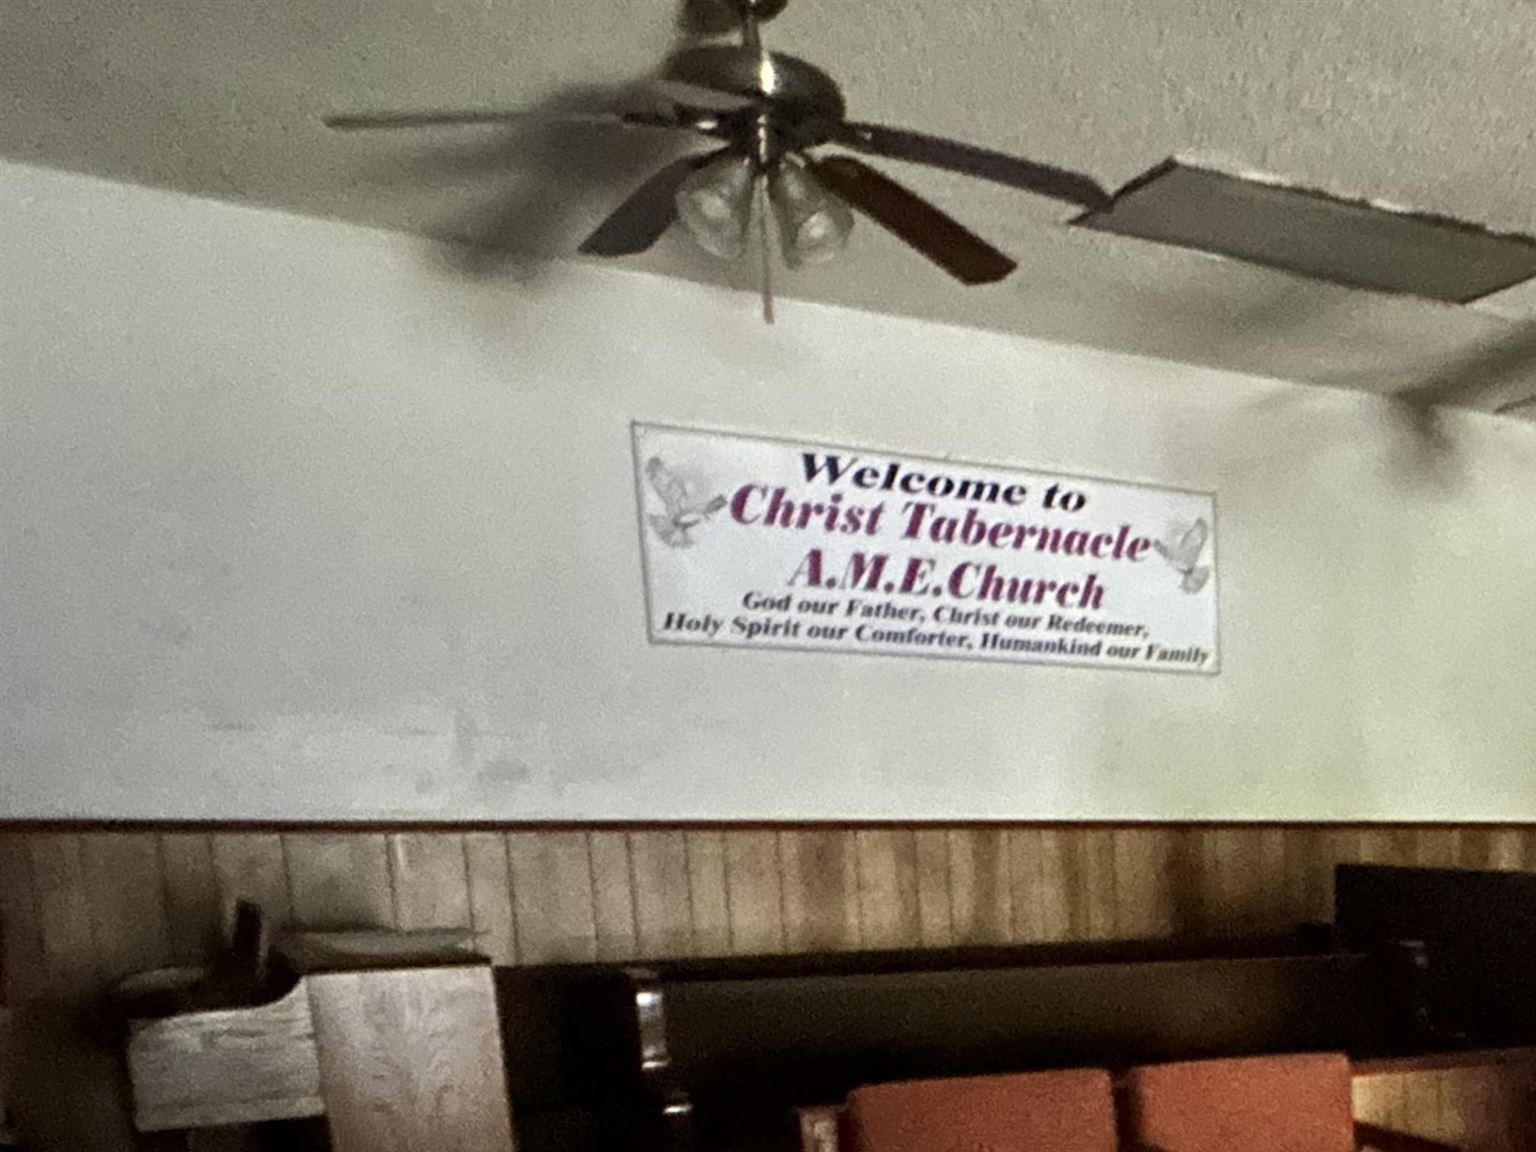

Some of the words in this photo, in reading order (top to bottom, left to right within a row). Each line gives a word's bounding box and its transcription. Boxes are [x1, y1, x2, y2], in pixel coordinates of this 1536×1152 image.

[802, 452, 1027, 506] Welcome
[1042, 483, 1087, 512] to
[730, 484, 884, 536] Christ
[902, 501, 1151, 562] Tabernacle
[663, 612, 722, 637] Holy
[730, 616, 800, 639] Spirit
[806, 623, 848, 640] our
[855, 625, 973, 650] Comforter,
[980, 632, 1101, 657] Humankind
[1106, 644, 1142, 658] our
[1145, 643, 1211, 667] Family
[742, 591, 791, 611] God
[797, 600, 838, 615] our
[845, 599, 926, 623] Father,
[933, 605, 1000, 626] Christ
[1004, 615, 1042, 629] our
[1047, 614, 1150, 638] Redeemer,
